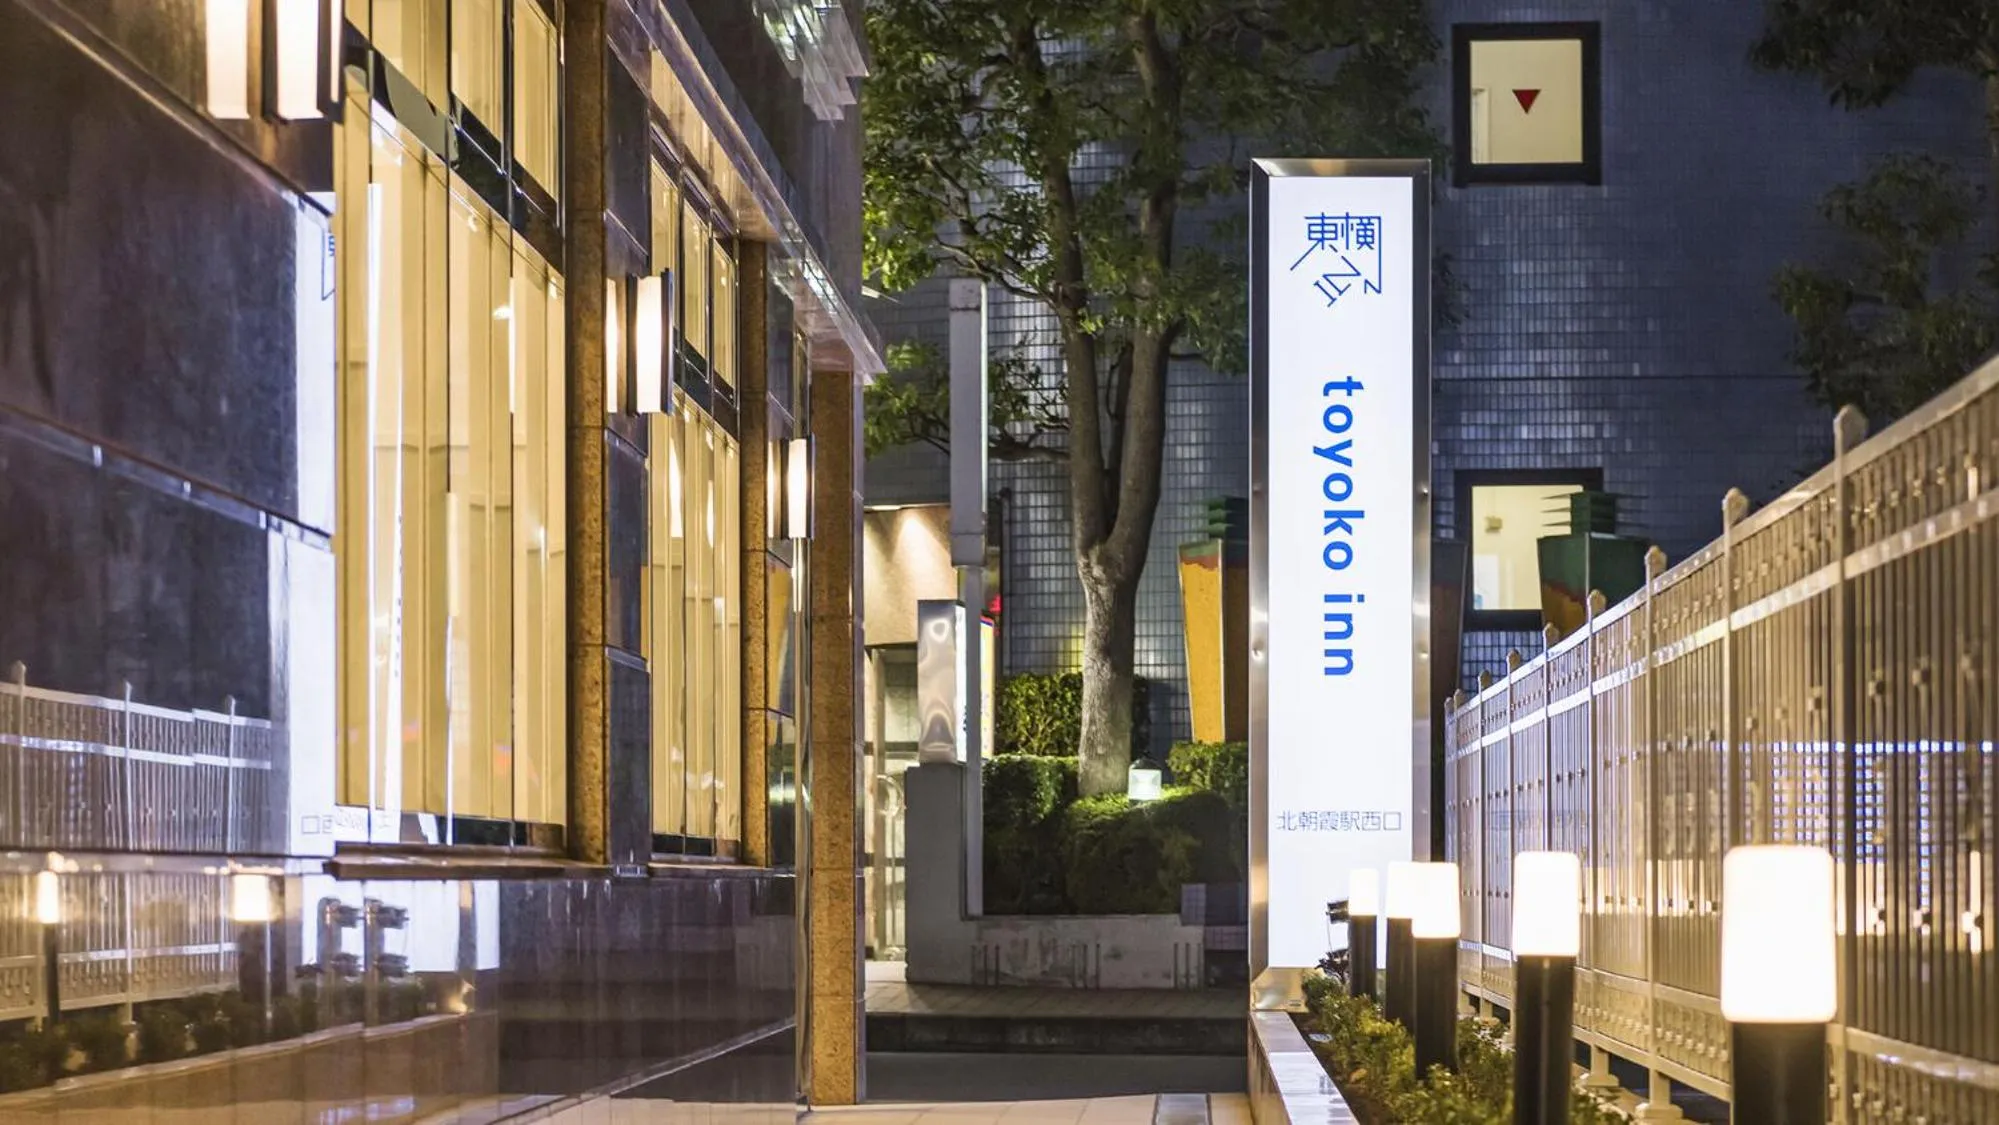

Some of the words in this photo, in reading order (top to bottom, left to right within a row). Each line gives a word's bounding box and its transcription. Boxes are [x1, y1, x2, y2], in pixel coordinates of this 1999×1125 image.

[1313, 376, 1365, 570] toyoko
[1323, 593, 1365, 676] inn
[1277, 810, 1402, 832] 北朝霞駅西口
